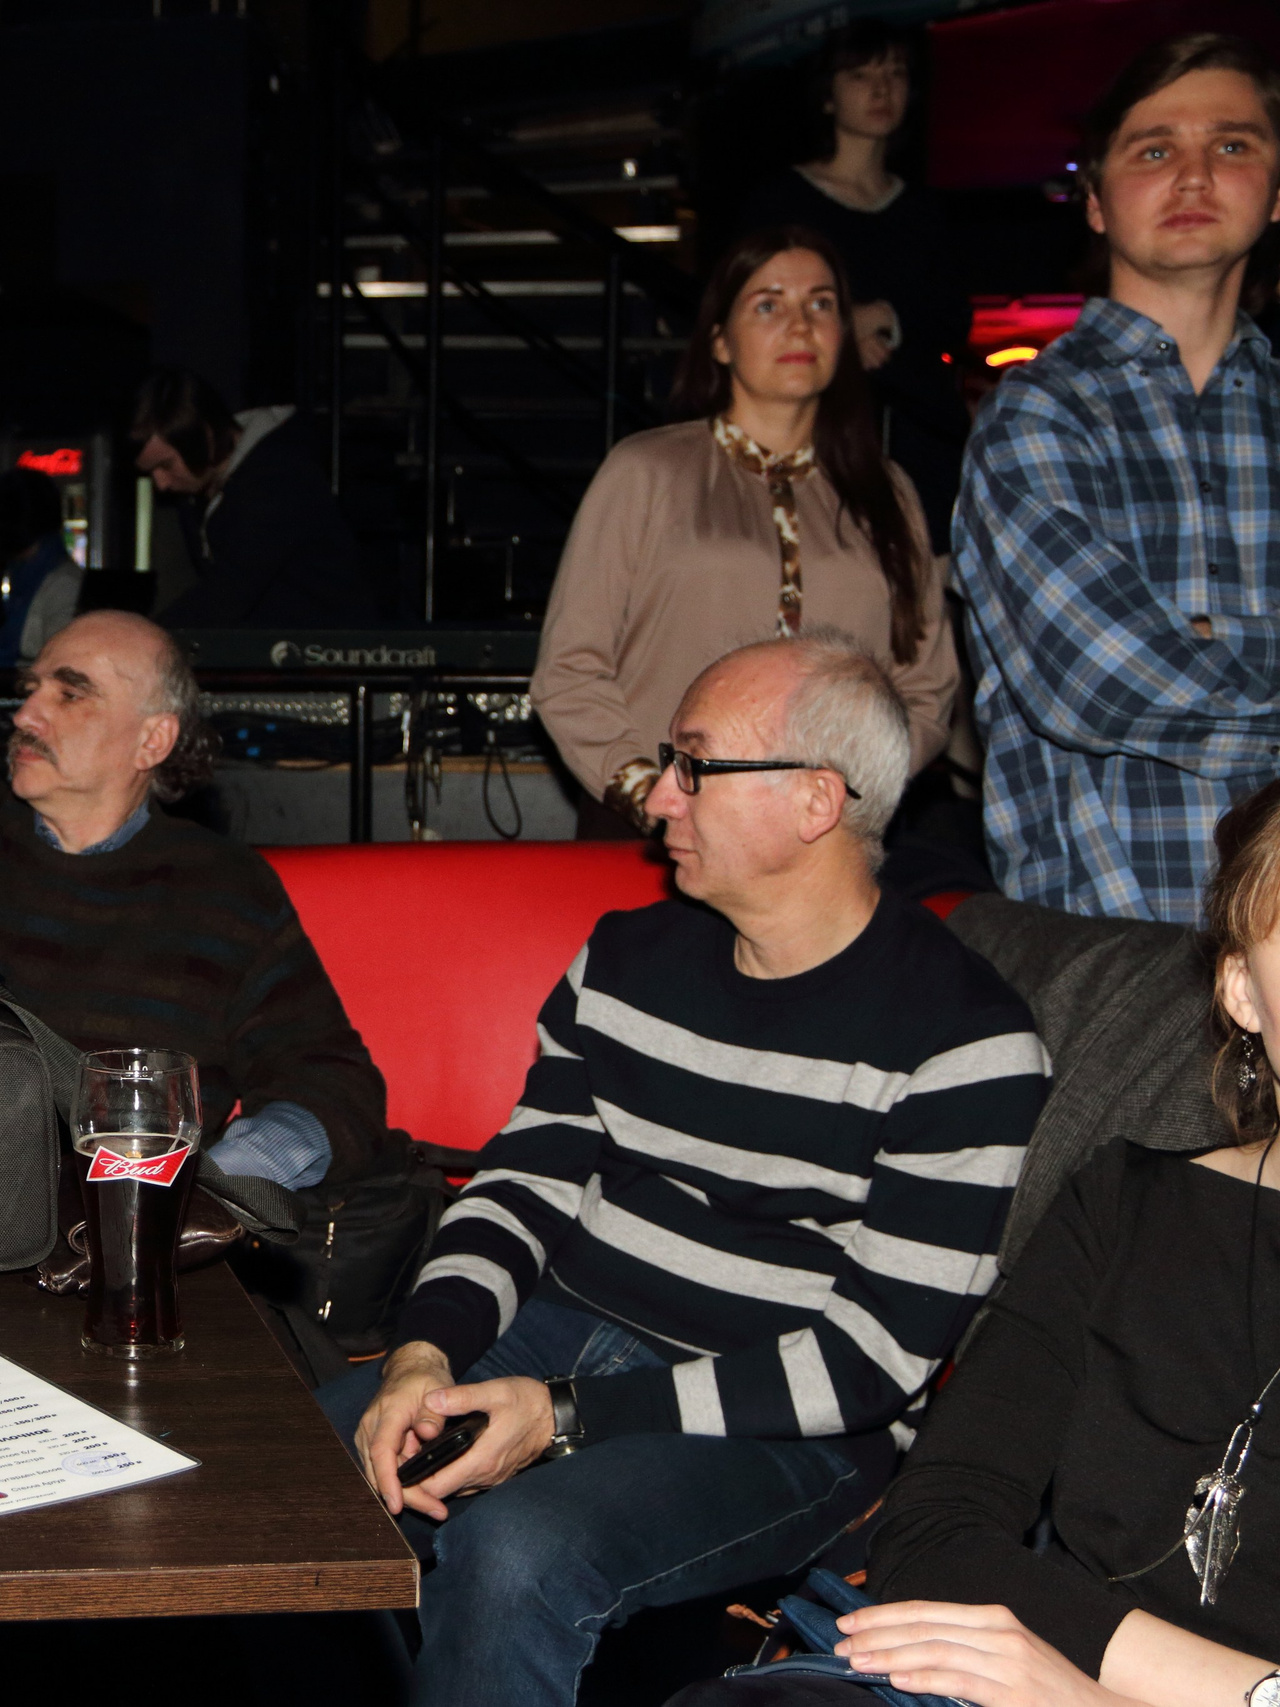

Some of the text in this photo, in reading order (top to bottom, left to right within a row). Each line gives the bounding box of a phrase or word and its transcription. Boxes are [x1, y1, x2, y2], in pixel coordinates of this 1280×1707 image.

[303, 644, 437, 667] Soundcraft
[99, 1157, 167, 1177] Bud
[72, 1436, 90, 1444] 200
[14, 1456, 45, 1467] Экстра
[36, 1466, 63, 1475] Белое
[11, 1483, 42, 1493] Стелла
